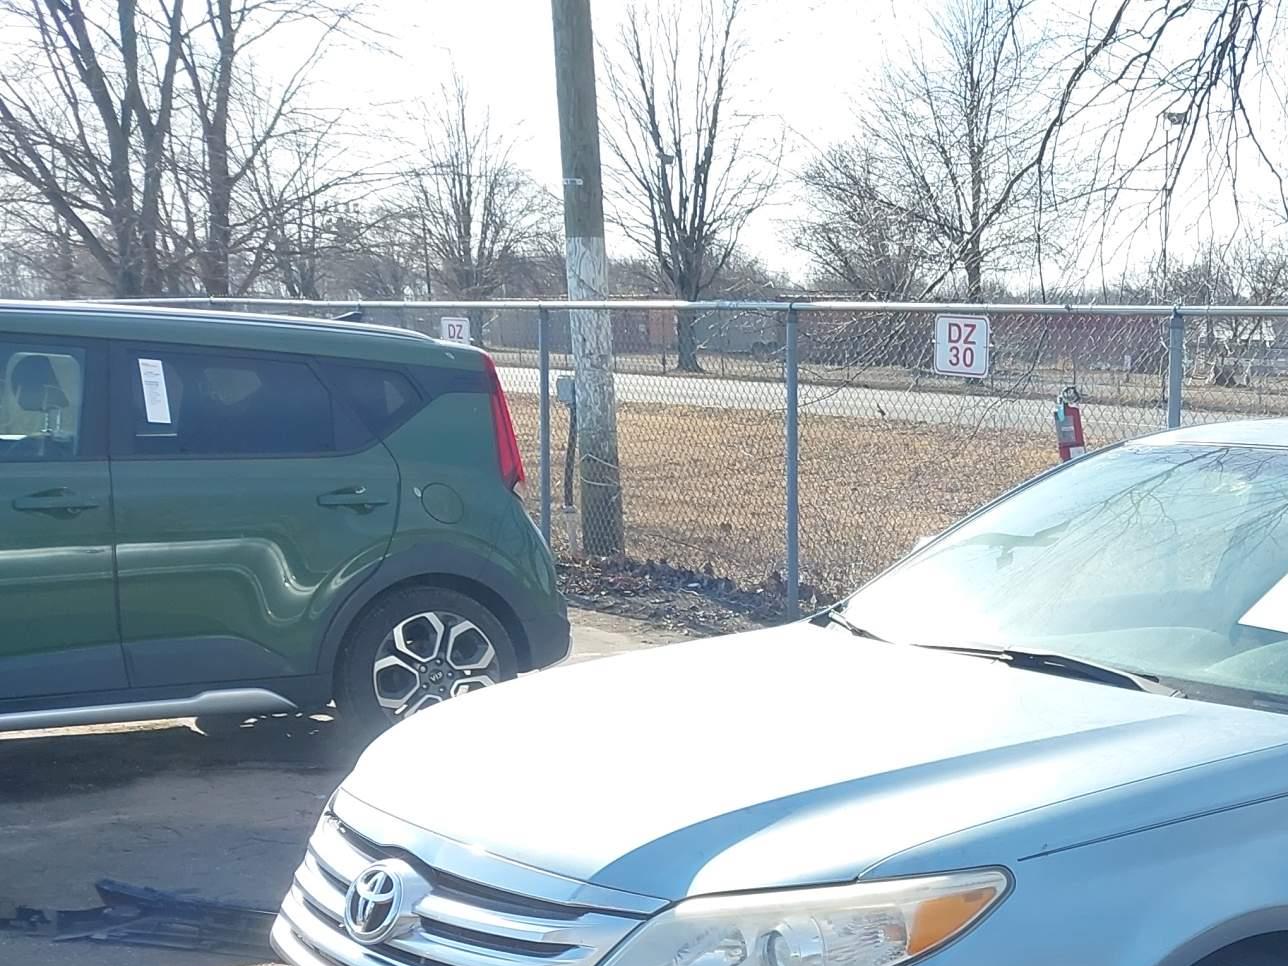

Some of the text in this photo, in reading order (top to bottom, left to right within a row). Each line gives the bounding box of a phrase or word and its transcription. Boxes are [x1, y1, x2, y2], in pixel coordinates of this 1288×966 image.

[448, 323, 463, 340] DZ
[948, 323, 976, 345] DZ
[949, 346, 974, 368] 30
